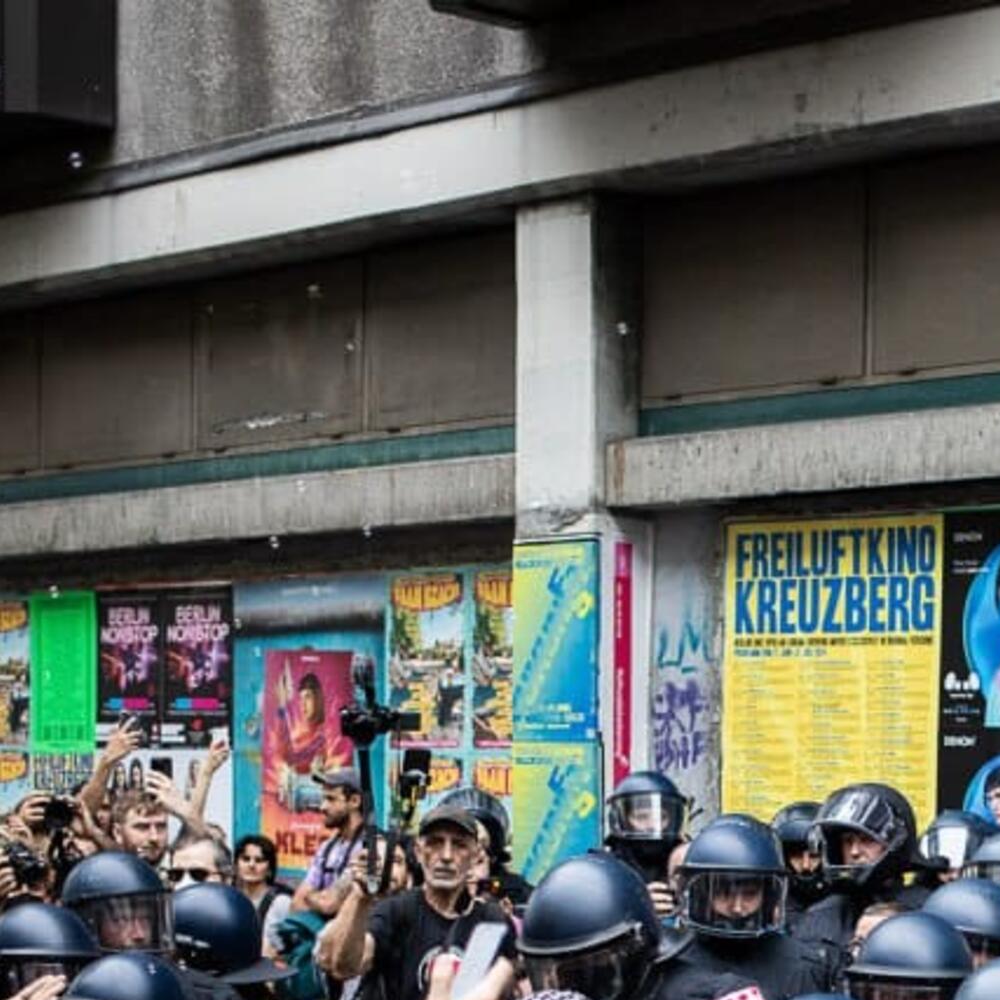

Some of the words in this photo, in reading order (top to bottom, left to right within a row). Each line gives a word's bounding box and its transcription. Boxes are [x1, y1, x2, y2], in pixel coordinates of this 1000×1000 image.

[735, 525, 936, 578] FREILUFTKINO
[175, 603, 221, 624] BERLIN
[734, 574, 936, 635] KREUZBERG
[108, 605, 150, 627] BERLIN
[100, 623, 159, 645] NONSTOP
[166, 621, 230, 643] NONSTOP
